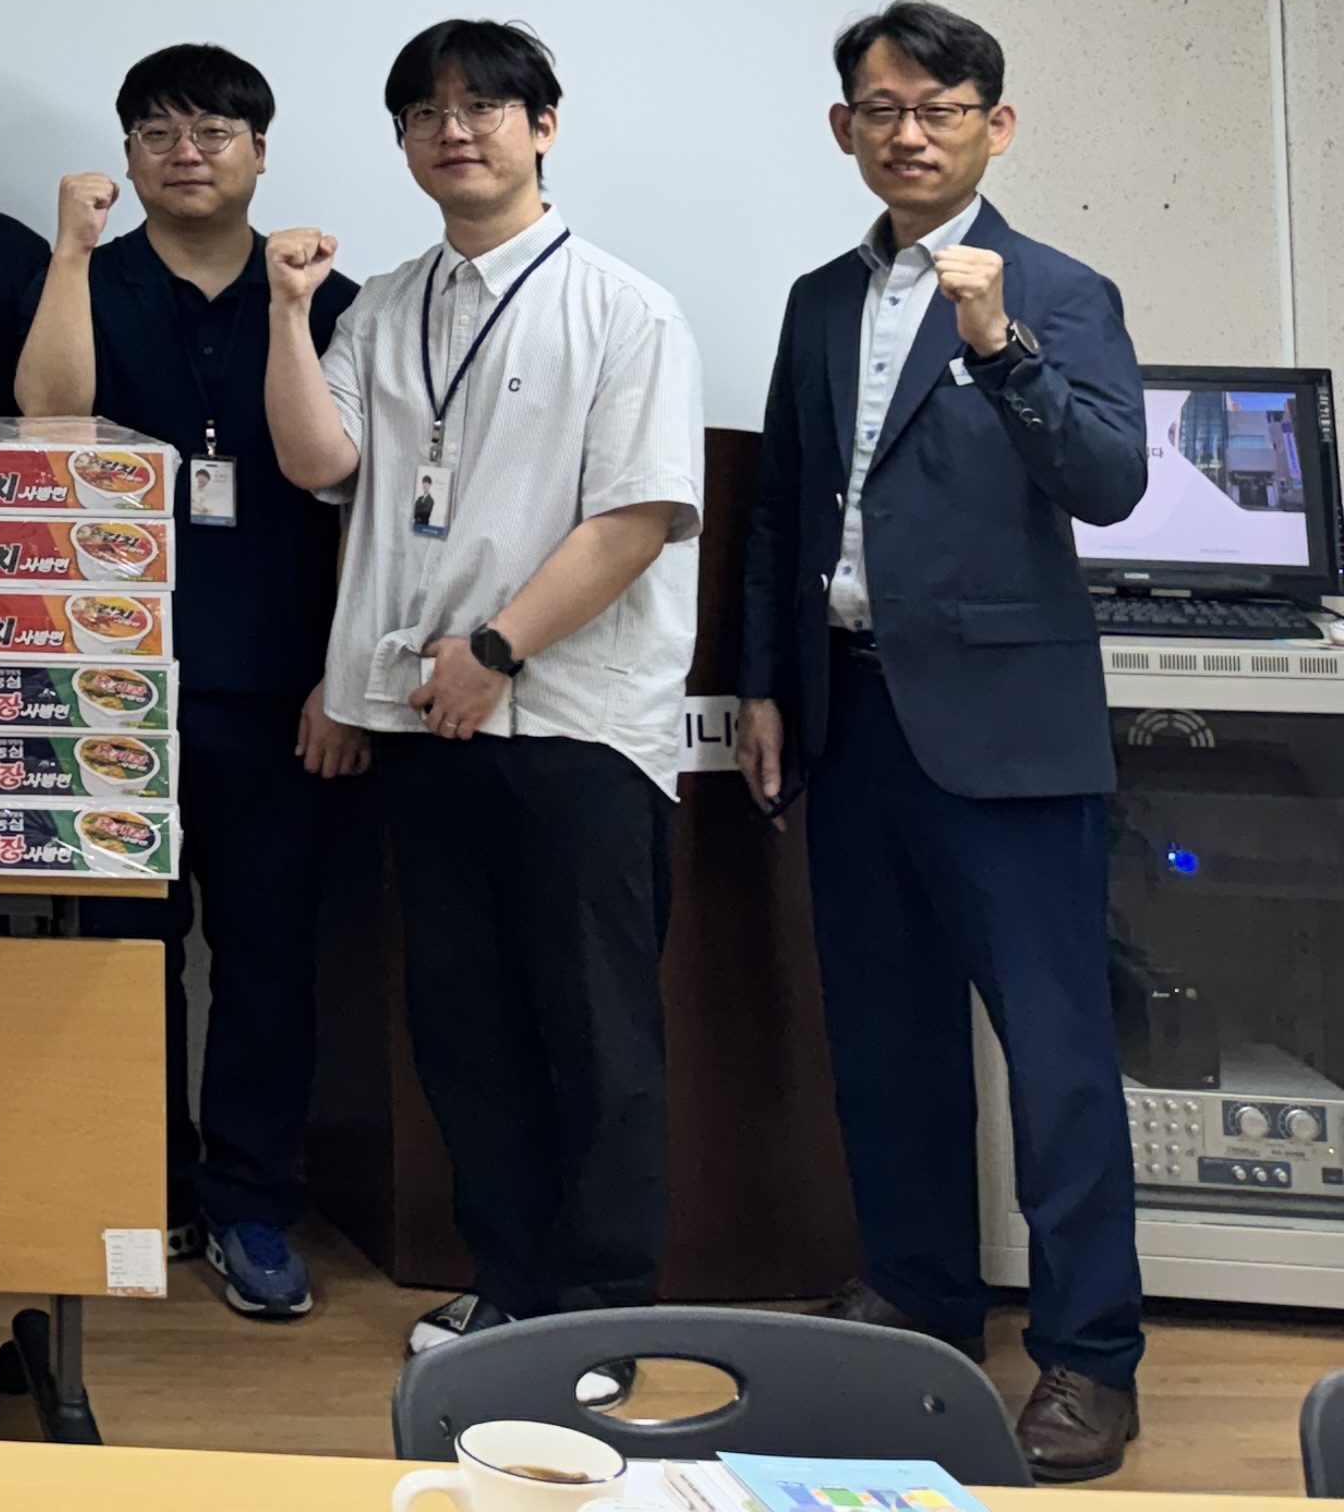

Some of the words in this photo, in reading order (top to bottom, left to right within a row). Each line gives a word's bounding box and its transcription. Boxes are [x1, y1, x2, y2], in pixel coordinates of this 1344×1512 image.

[508, 378, 521, 392] C
[18, 486, 67, 501] 사발면
[20, 557, 70, 573] 사발면
[15, 630, 65, 646] 사발면
[21, 704, 70, 719] 사발면
[23, 773, 72, 788] 사발면
[24, 847, 72, 862] 사발면
